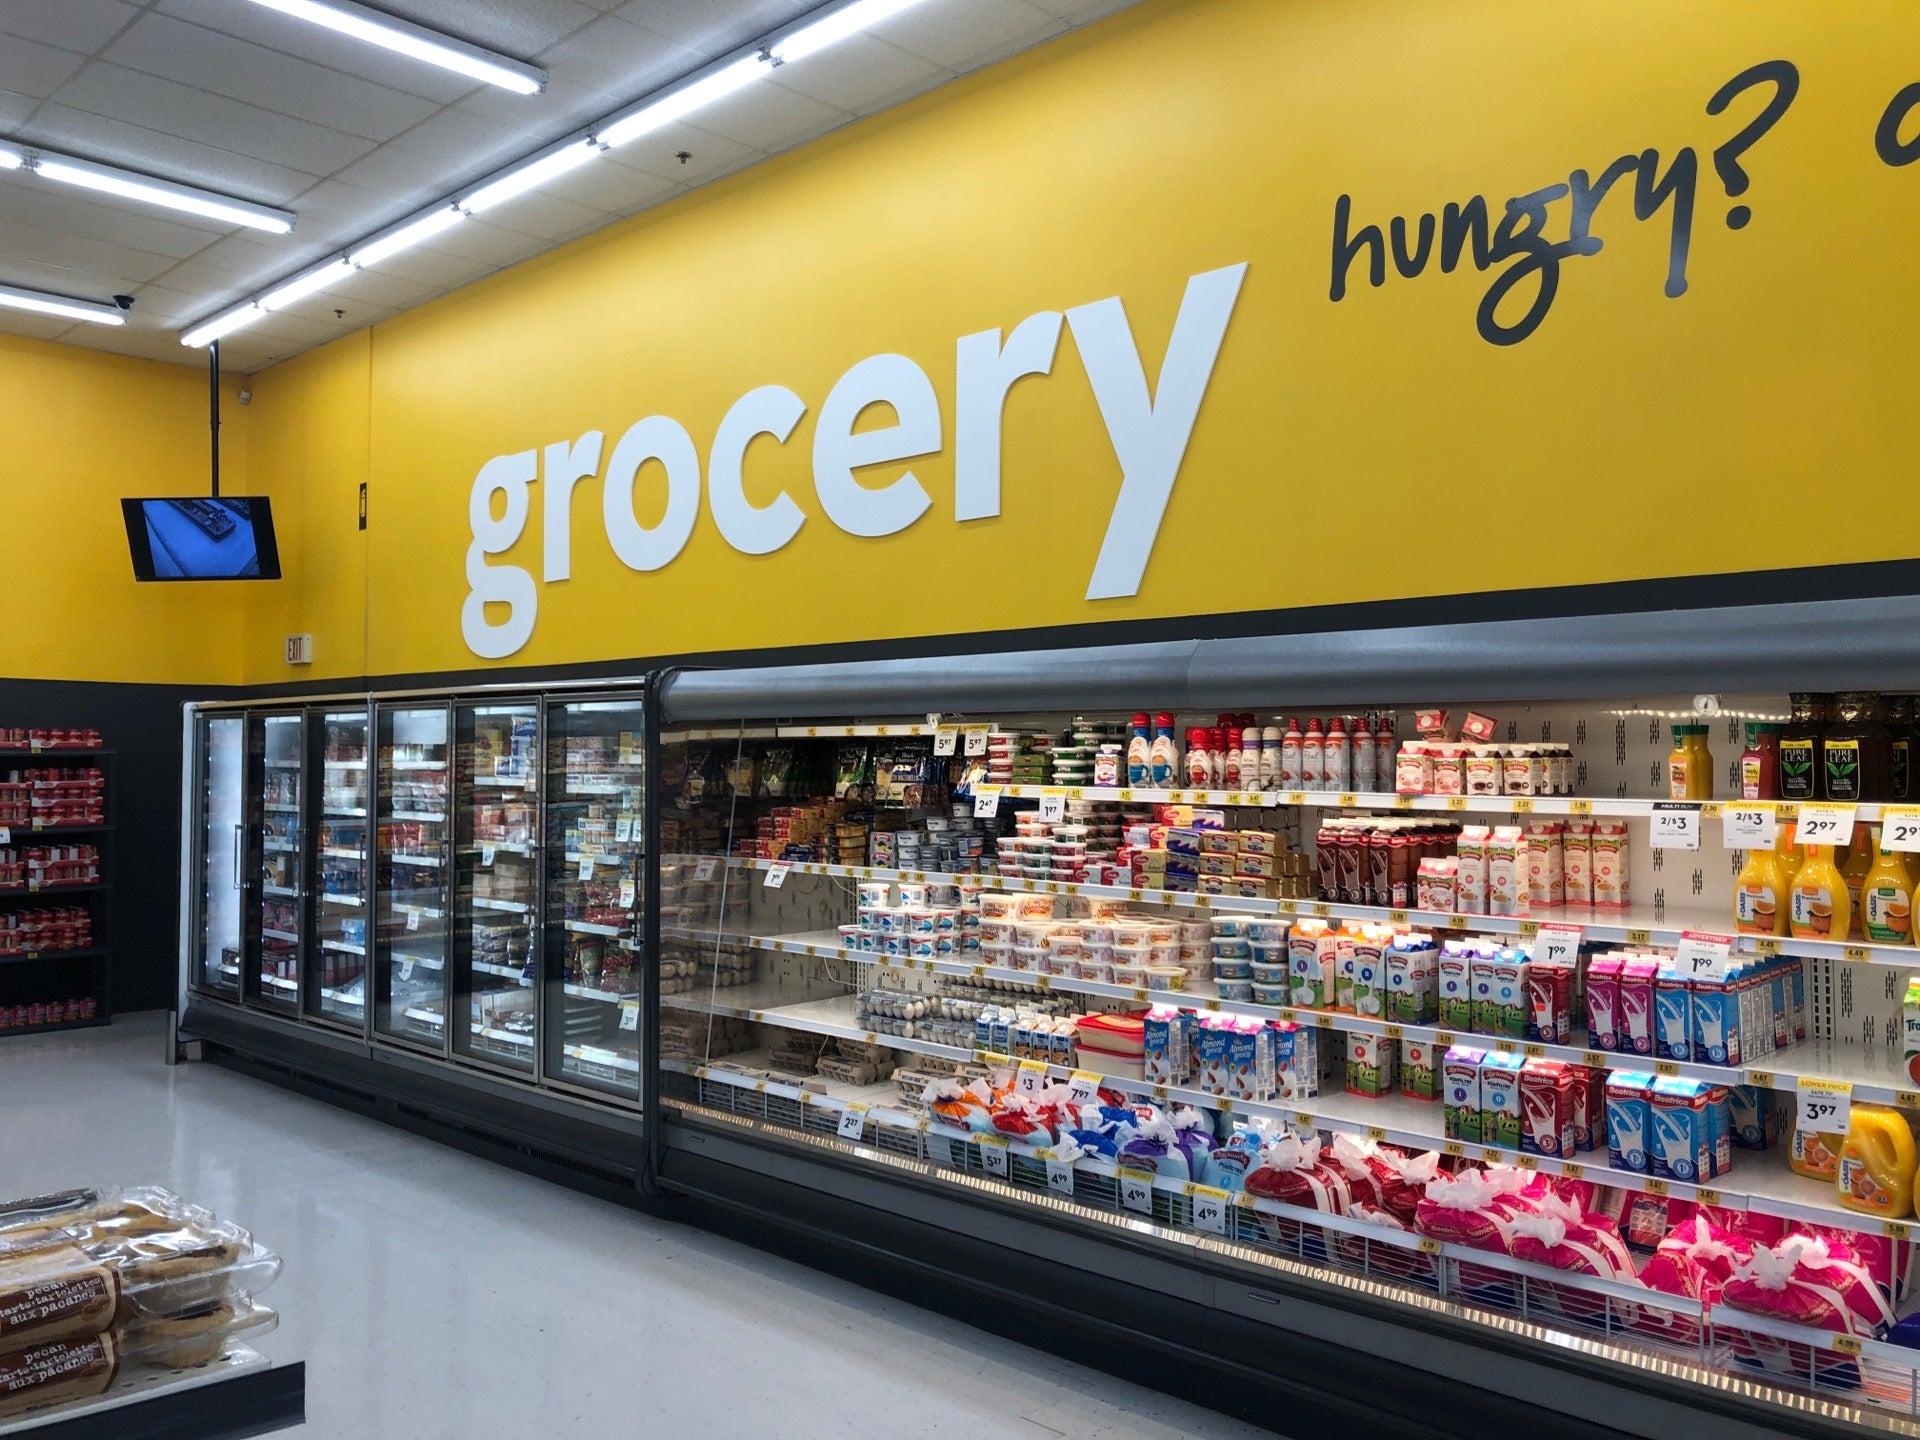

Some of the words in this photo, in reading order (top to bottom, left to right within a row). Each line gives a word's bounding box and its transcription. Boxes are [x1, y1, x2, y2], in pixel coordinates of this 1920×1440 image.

[1330, 60, 1799, 346] hungry?
[461, 261, 1249, 659] grocery
[288, 638, 302, 661] EXIT
[1631, 933, 1645, 941] 3.17
[1689, 932, 1728, 943] ADVERTISED
[1623, 976, 1647, 984] Beatrice
[1658, 981, 1685, 989] Beatrice
[1696, 983, 1722, 991] Beatrice
[1201, 1038, 1226, 1050] Almond
[1229, 1042, 1254, 1054] Almond
[1523, 1075, 1554, 1085] Beatrice
[1801, 1080, 1826, 1089] LOWER
[1609, 1086, 1641, 1098] Beatrice
[1655, 1095, 1689, 1106] Beatrice
[25, 1280, 68, 1299] pecan
[10, 1309, 37, 1325] aux
[40, 1288, 96, 1317] pacanes
[24, 1343, 67, 1364] pecan
[8, 1375, 36, 1391] aux
[38, 1353, 95, 1383] pacanes
